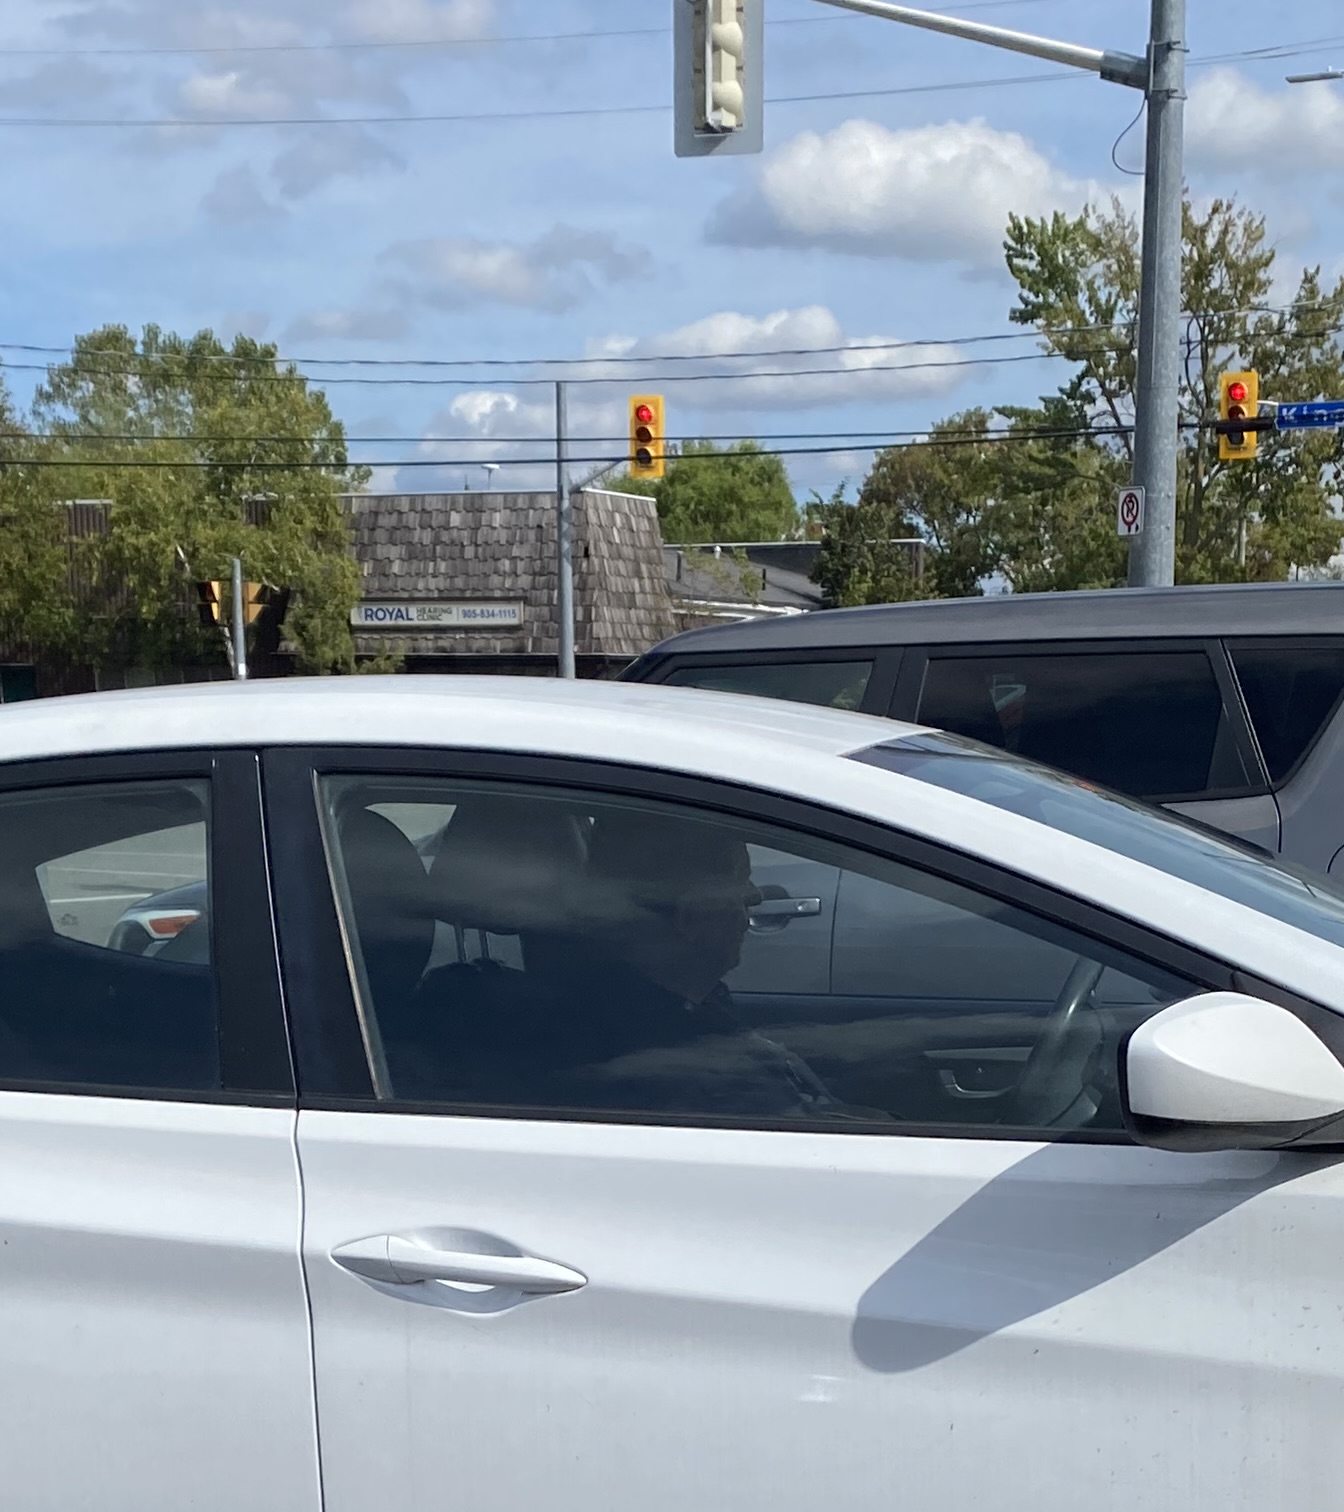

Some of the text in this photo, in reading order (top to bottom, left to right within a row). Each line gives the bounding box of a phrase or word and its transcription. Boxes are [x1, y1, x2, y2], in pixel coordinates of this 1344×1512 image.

[364, 606, 453, 621] ROYAL HEARING
[416, 614, 443, 622] CLINIC
[462, 608, 517, 619] 905-834-1115
